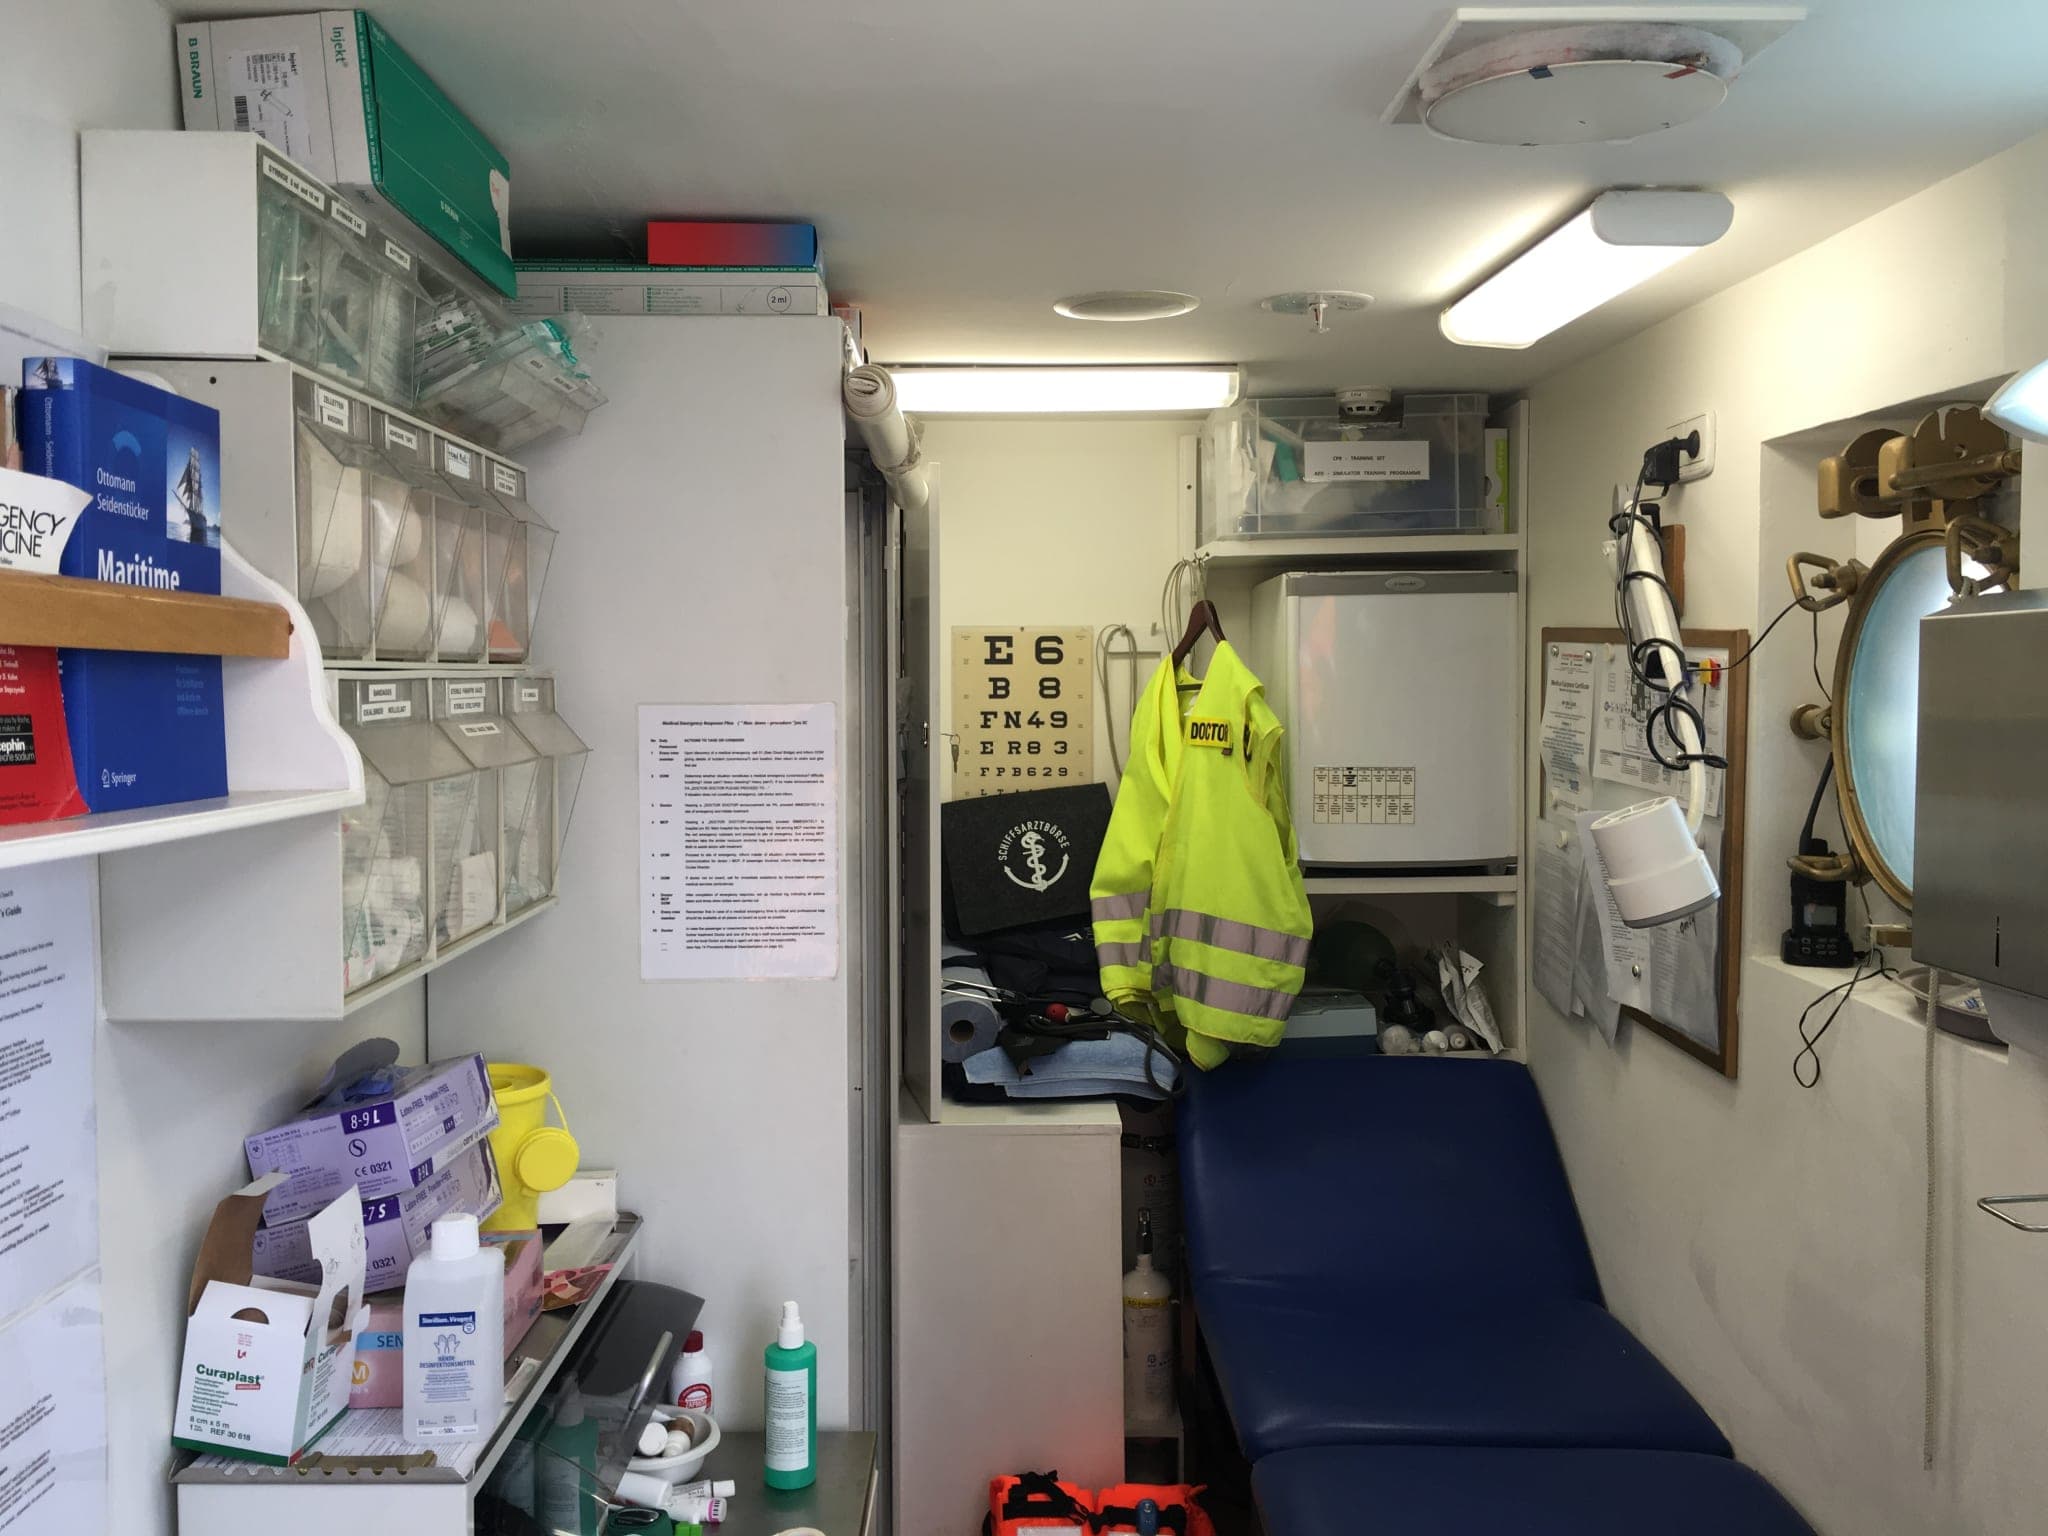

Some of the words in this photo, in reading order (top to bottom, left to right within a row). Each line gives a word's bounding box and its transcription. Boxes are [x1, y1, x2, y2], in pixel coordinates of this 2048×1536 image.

[189, 51, 203, 99] BRAUN
[771, 296, 779, 304] 2
[780, 295, 787, 304] ml
[96, 467, 136, 494] Ottomann
[96, 492, 149, 520] Seidenstücker
[98, 548, 181, 591] Maritime
[984, 635, 1014, 665] E
[1034, 635, 1064, 665] 6
[988, 677, 1010, 699] B
[1038, 677, 1061, 699] 8
[111, 772, 137, 788] Springer
[997, 819, 1070, 861] SCHIFFSARZTBÖRSE
[351, 1111, 369, 1129] 8-9
[372, 1109, 380, 1124] L
[369, 1161, 393, 1174] 0321
[378, 1203, 386, 1219] S
[372, 1256, 396, 1270] 0321
[196, 1363, 260, 1386] Curaplast
[210, 1427, 225, 1436] REF
